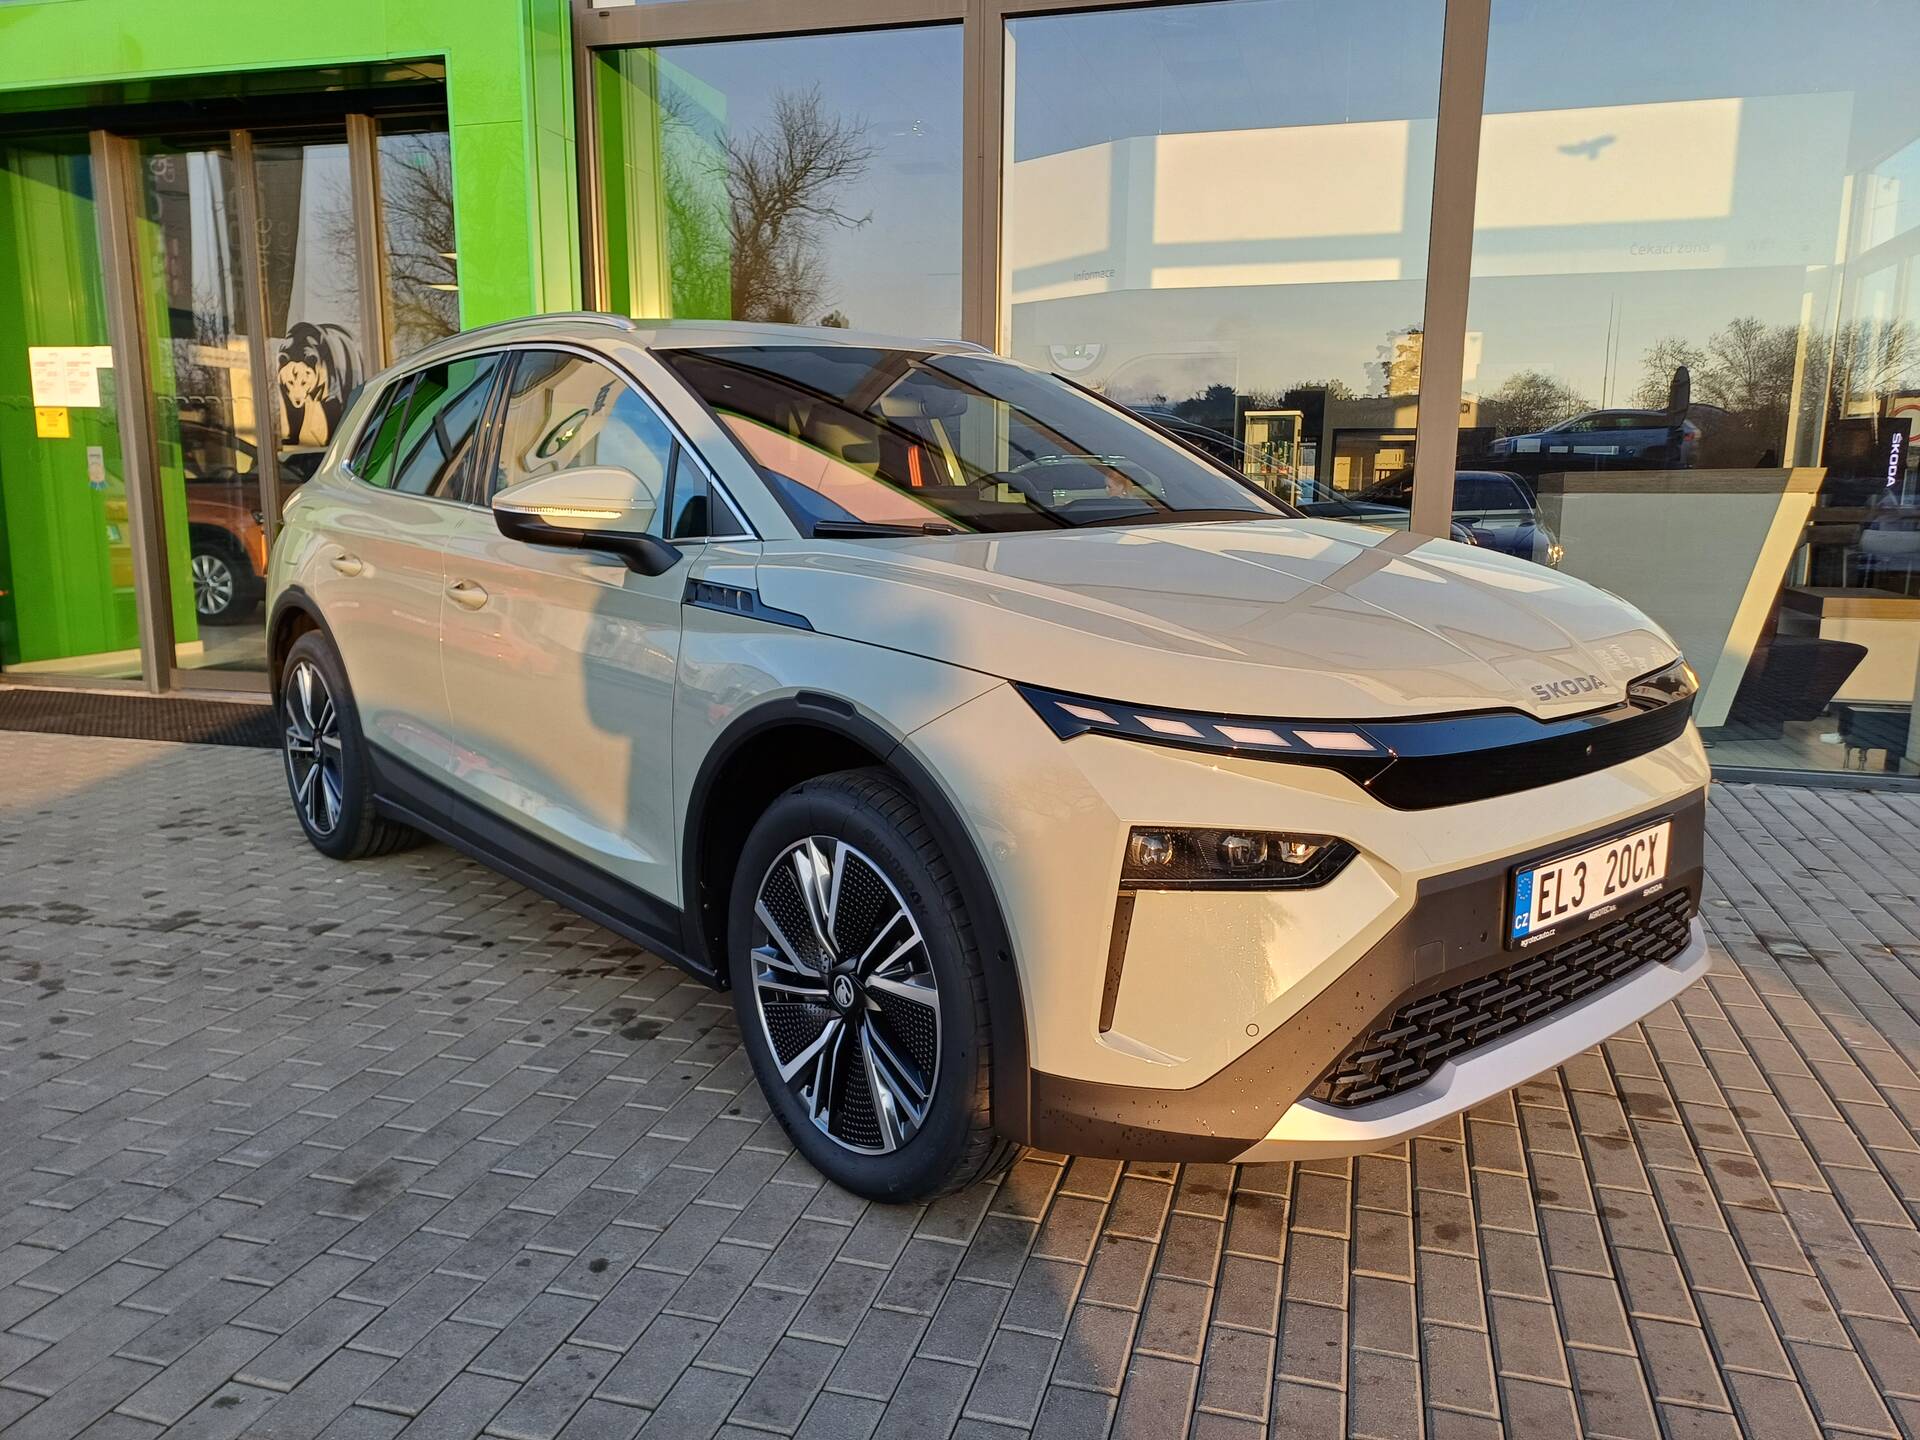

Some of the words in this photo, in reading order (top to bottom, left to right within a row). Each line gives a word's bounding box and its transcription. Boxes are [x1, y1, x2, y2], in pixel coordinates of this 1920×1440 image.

[1538, 861, 1587, 922] EL3
[1604, 833, 1658, 896] 20CX
[1515, 912, 1529, 930] CZ
